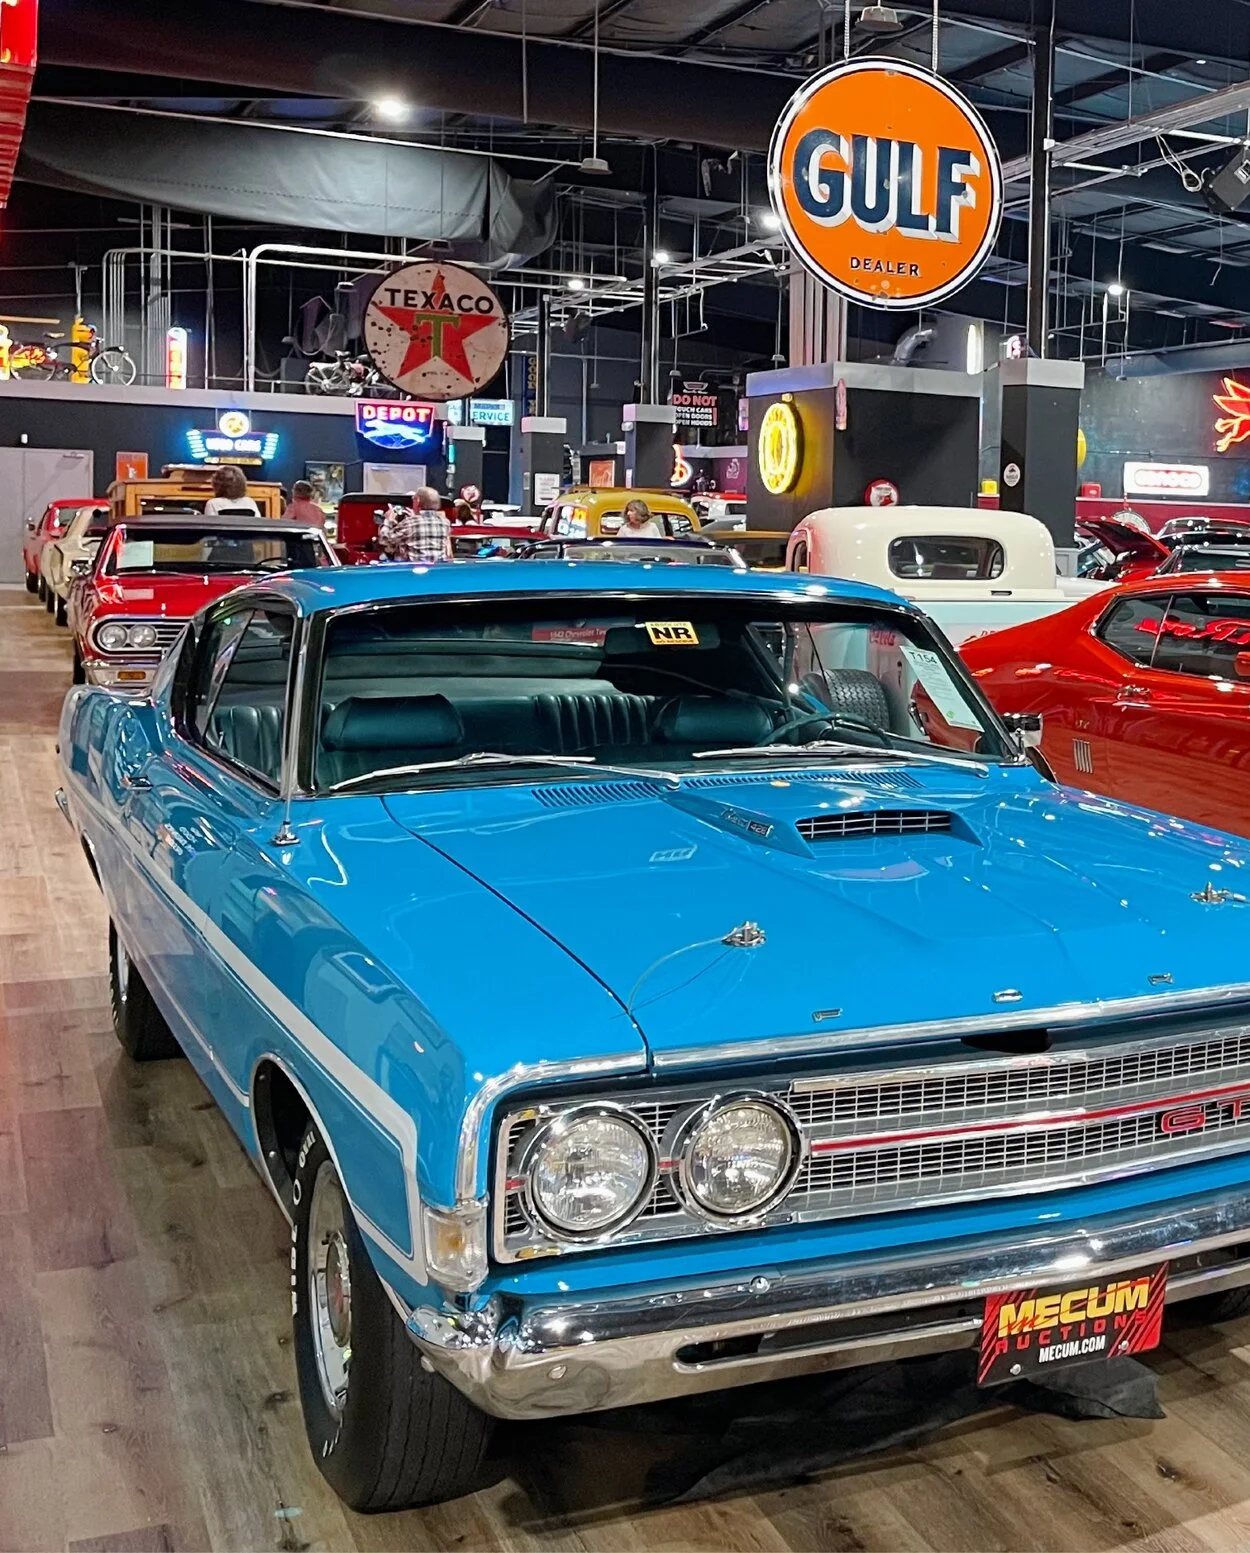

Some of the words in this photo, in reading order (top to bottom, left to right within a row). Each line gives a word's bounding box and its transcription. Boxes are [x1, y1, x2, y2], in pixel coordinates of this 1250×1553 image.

[793, 127, 980, 243] GULF
[850, 256, 921, 277] DEALER
[384, 288, 494, 314] TEXACO
[673, 394, 691, 405] DO
[692, 395, 717, 406] NOT
[362, 405, 431, 422] DEPOT
[472, 411, 511, 422] ERVICE
[651, 627, 692, 639] NR
[998, 1276, 1151, 1338] MECUM
[995, 1310, 1148, 1355] AUCTIONS
[1038, 1335, 1106, 1363] MECUM.COM
